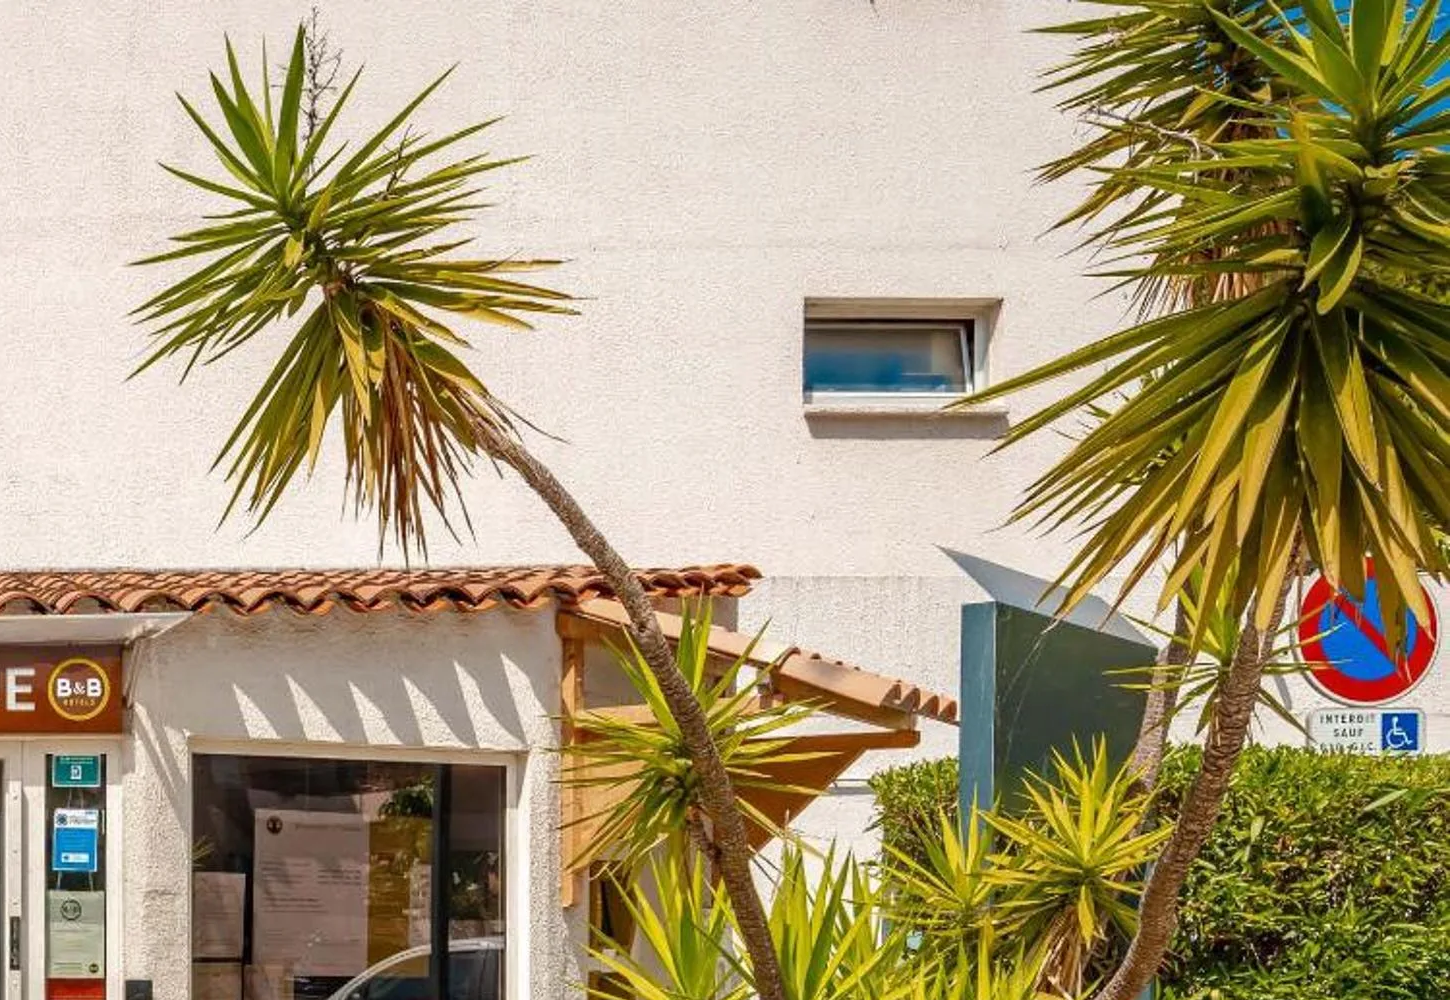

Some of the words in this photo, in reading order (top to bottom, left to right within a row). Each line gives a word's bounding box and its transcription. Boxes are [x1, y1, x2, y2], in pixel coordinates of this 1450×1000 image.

[57, 678, 102, 697] B&B
[1319, 713, 1376, 724] INTERDIT
[1333, 727, 1364, 738] SAUF
